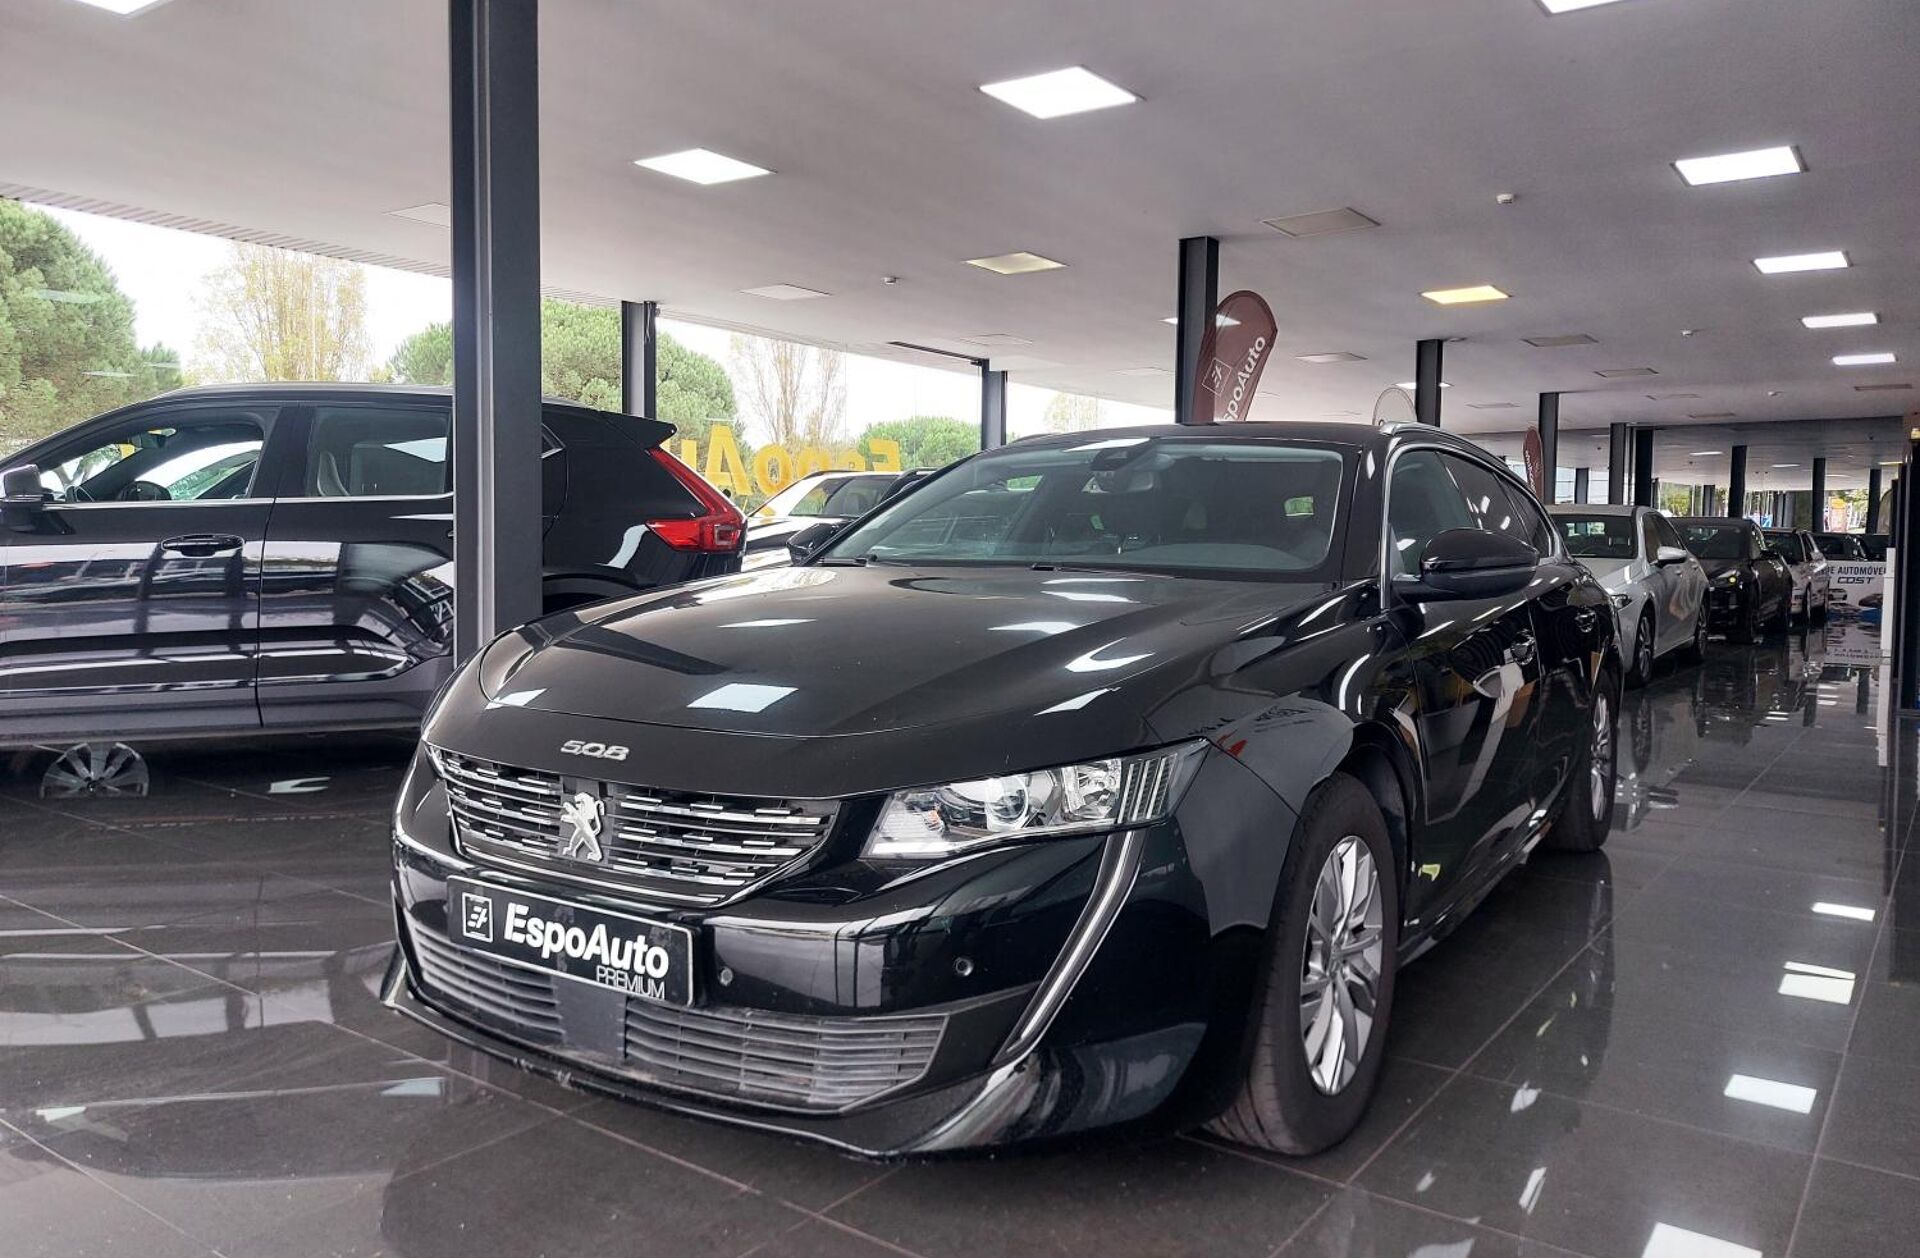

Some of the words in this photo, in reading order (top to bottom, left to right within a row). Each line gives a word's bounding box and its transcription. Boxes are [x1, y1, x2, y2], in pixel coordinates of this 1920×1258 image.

[1837, 576, 1875, 585] COST
[560, 739, 630, 761] 508
[504, 902, 669, 979] EspoAuto
[596, 965, 665, 999] PREMIUM
